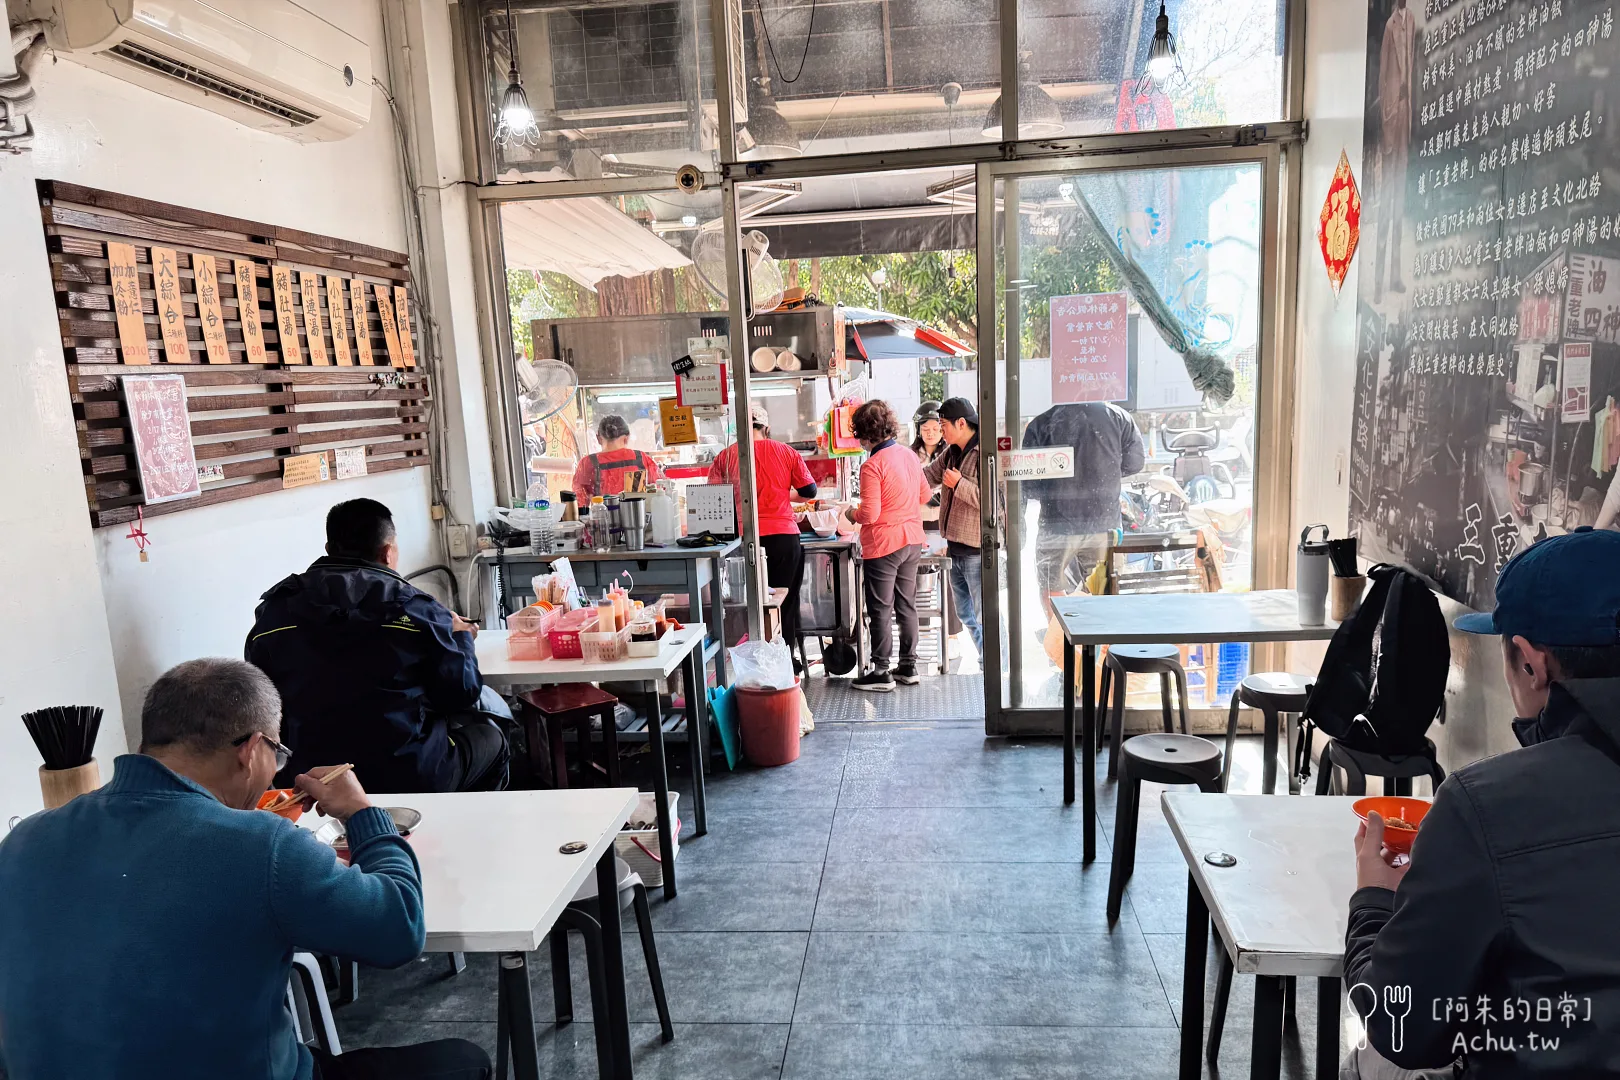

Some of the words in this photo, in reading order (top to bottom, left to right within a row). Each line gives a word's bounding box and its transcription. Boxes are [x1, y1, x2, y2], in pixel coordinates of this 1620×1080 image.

[159, 253, 183, 324] 大綜合
[199, 260, 219, 328] 小綜合
[239, 266, 257, 336] 豬腸冬粉
[276, 272, 293, 336] 豬肚湯
[304, 279, 319, 337] 肝連湯
[330, 282, 344, 340] 小肚湯
[353, 287, 367, 339] 四神湯
[170, 344, 185, 355] 100
[213, 345, 225, 356] 70
[252, 346, 262, 356] 60
[287, 348, 298, 357] 50
[314, 350, 324, 359] 50
[339, 351, 348, 360] 50
[1458, 503, 1550, 575] 三重
